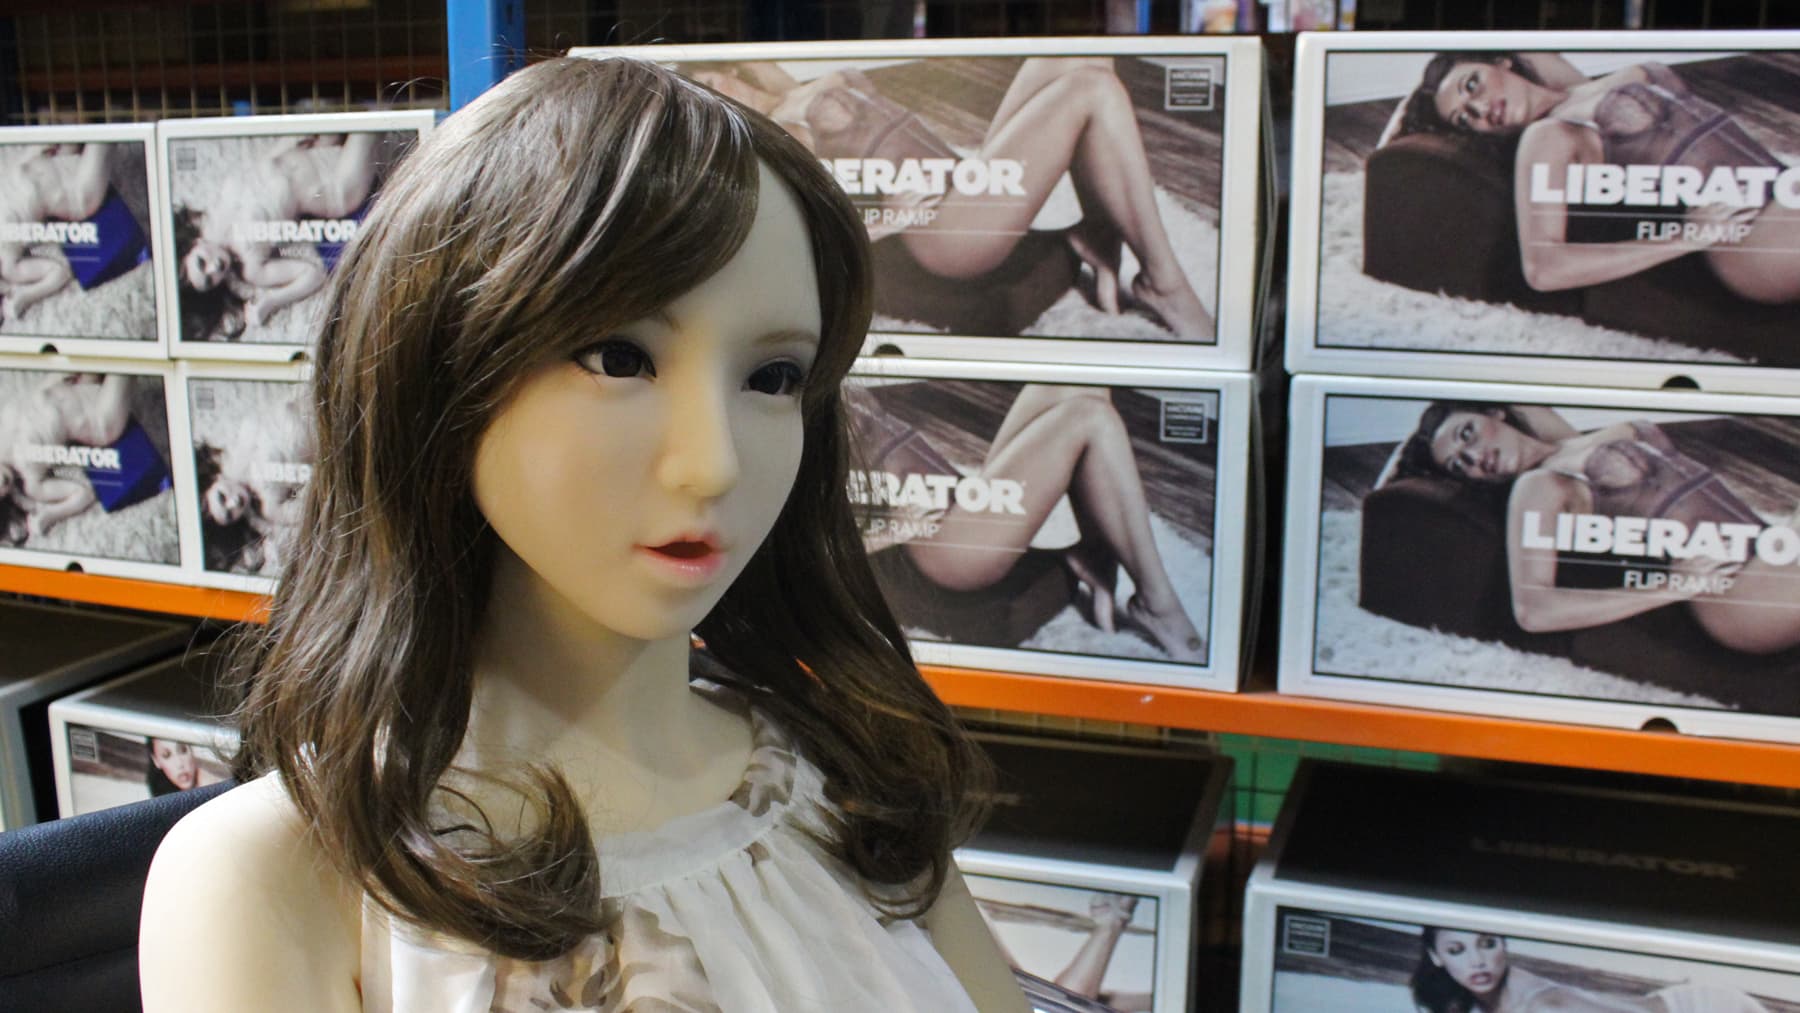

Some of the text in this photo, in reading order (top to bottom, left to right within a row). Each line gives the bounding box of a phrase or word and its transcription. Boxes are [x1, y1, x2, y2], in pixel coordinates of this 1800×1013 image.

[819, 158, 1026, 196] ERATOR
[883, 208, 937, 226] RAMP
[232, 219, 357, 242] LIBERATOR
[1636, 221, 1752, 244] FLIP RAMP
[846, 470, 1027, 515] ERATOR
[1521, 511, 1800, 566] LIBERATO
[1624, 570, 1736, 594] FLIP RAMP
